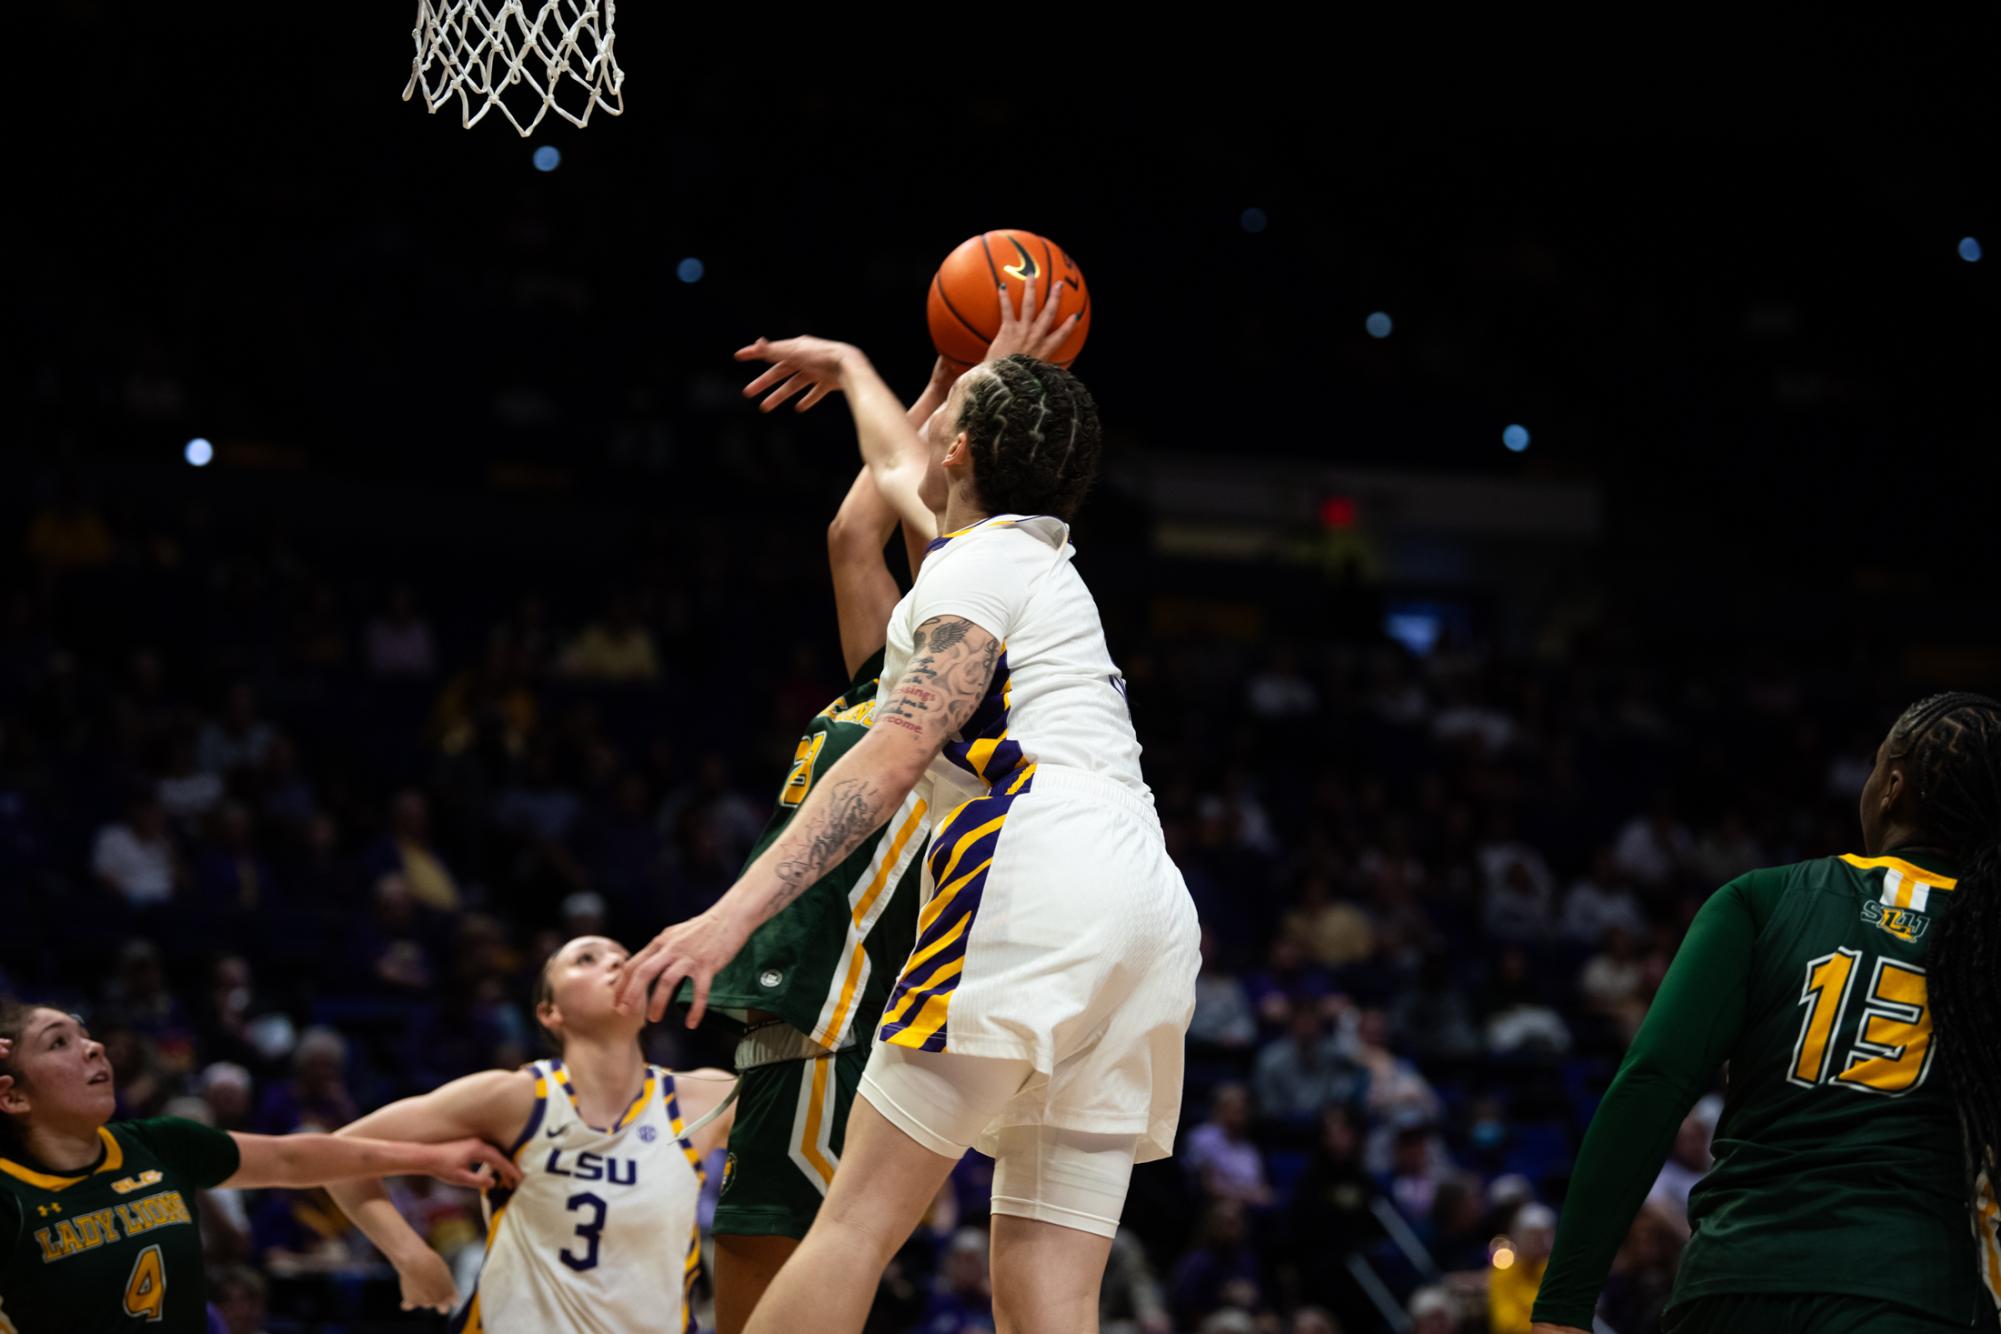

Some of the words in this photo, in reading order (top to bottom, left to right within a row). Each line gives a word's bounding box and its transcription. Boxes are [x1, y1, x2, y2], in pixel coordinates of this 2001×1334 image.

[1785, 945, 1937, 1098] 13
[545, 1148, 637, 1185] LSU
[34, 1207, 121, 1264] LADY
[560, 1192, 607, 1272] 3
[123, 1243, 167, 1323] 4
